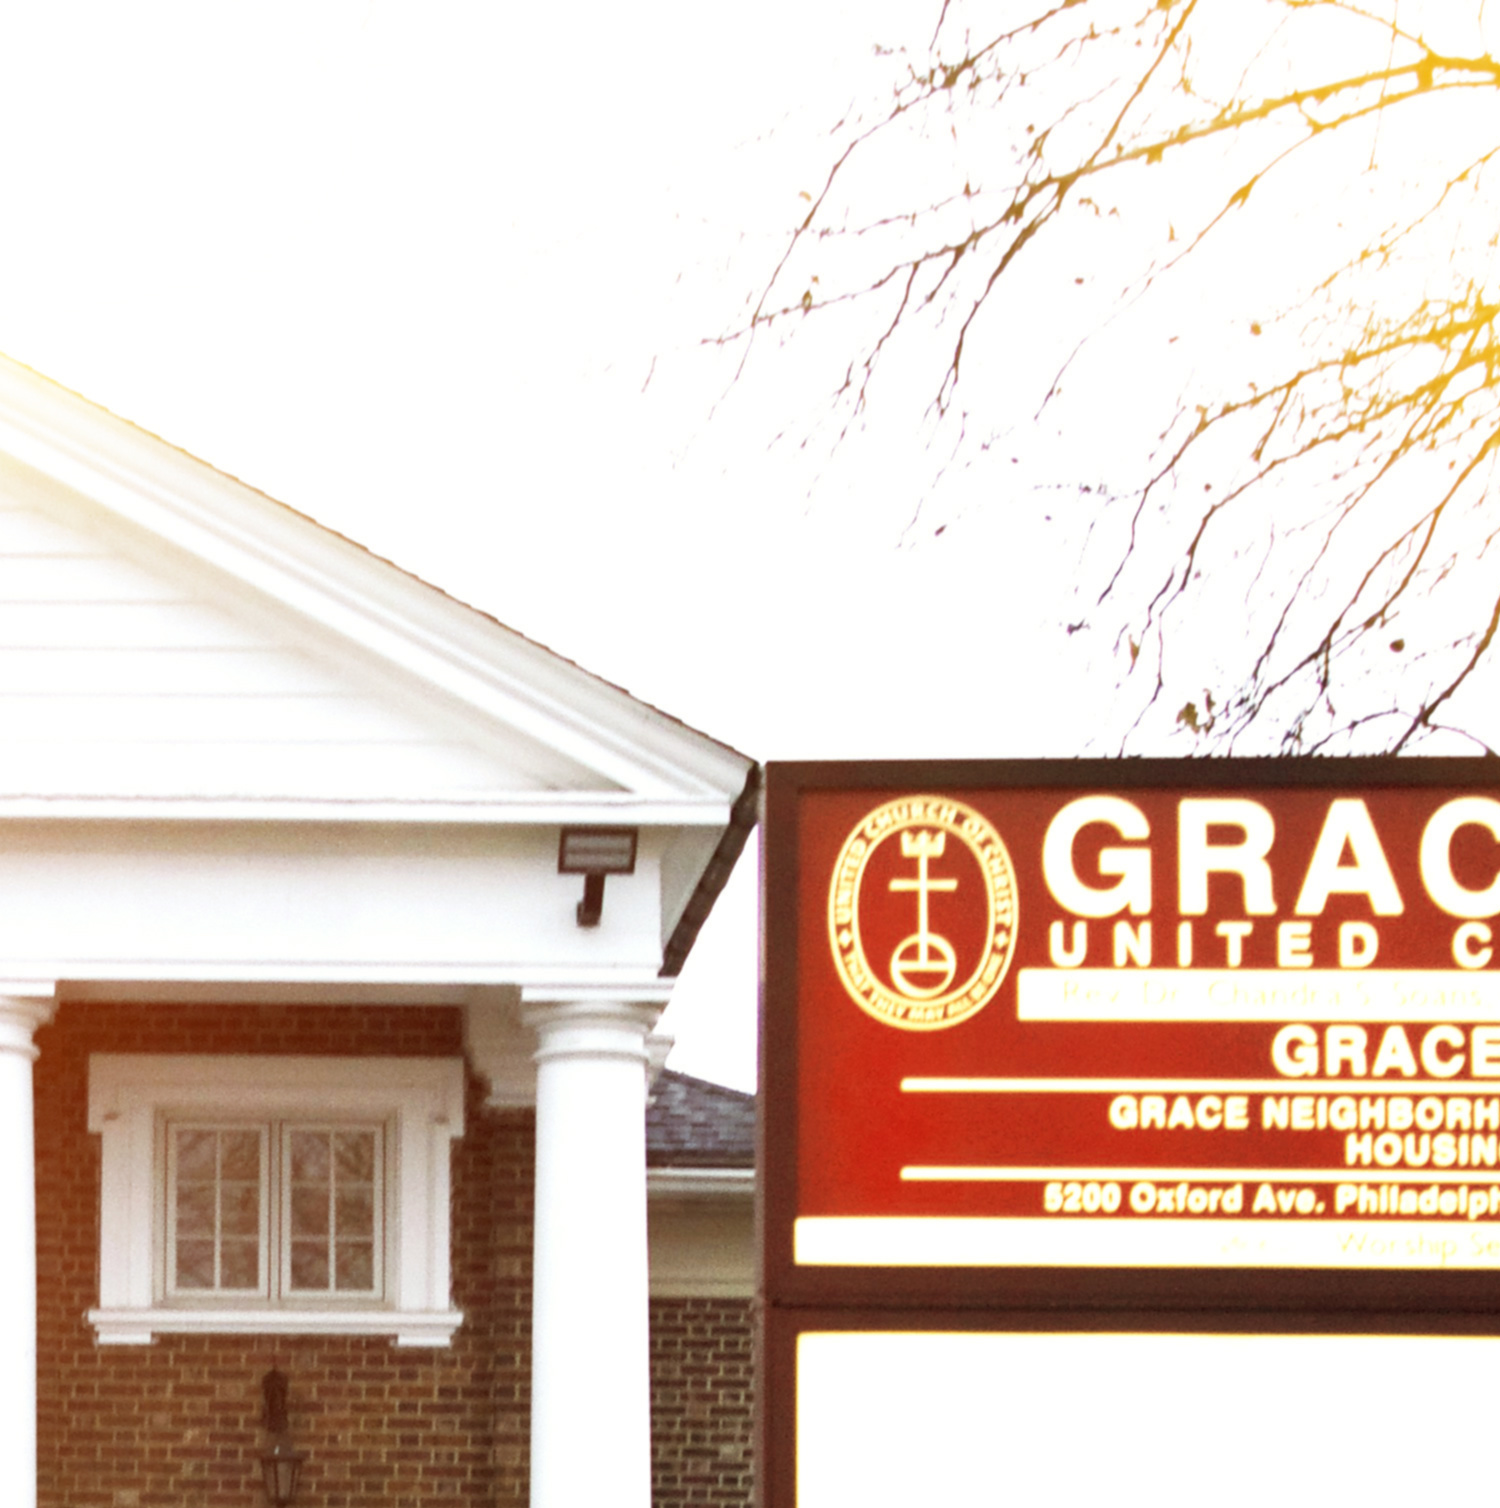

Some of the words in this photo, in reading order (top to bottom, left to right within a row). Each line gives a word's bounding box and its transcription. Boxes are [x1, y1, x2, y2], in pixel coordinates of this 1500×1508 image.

[863, 802, 957, 839] CHURCH
[1049, 922, 1380, 968] UNITED
[1109, 1095, 1250, 1130] GRACE
[1044, 1183, 1123, 1213] 5200
[1129, 1182, 1244, 1213] Oxford
[1253, 1184, 1326, 1214] Ave.
